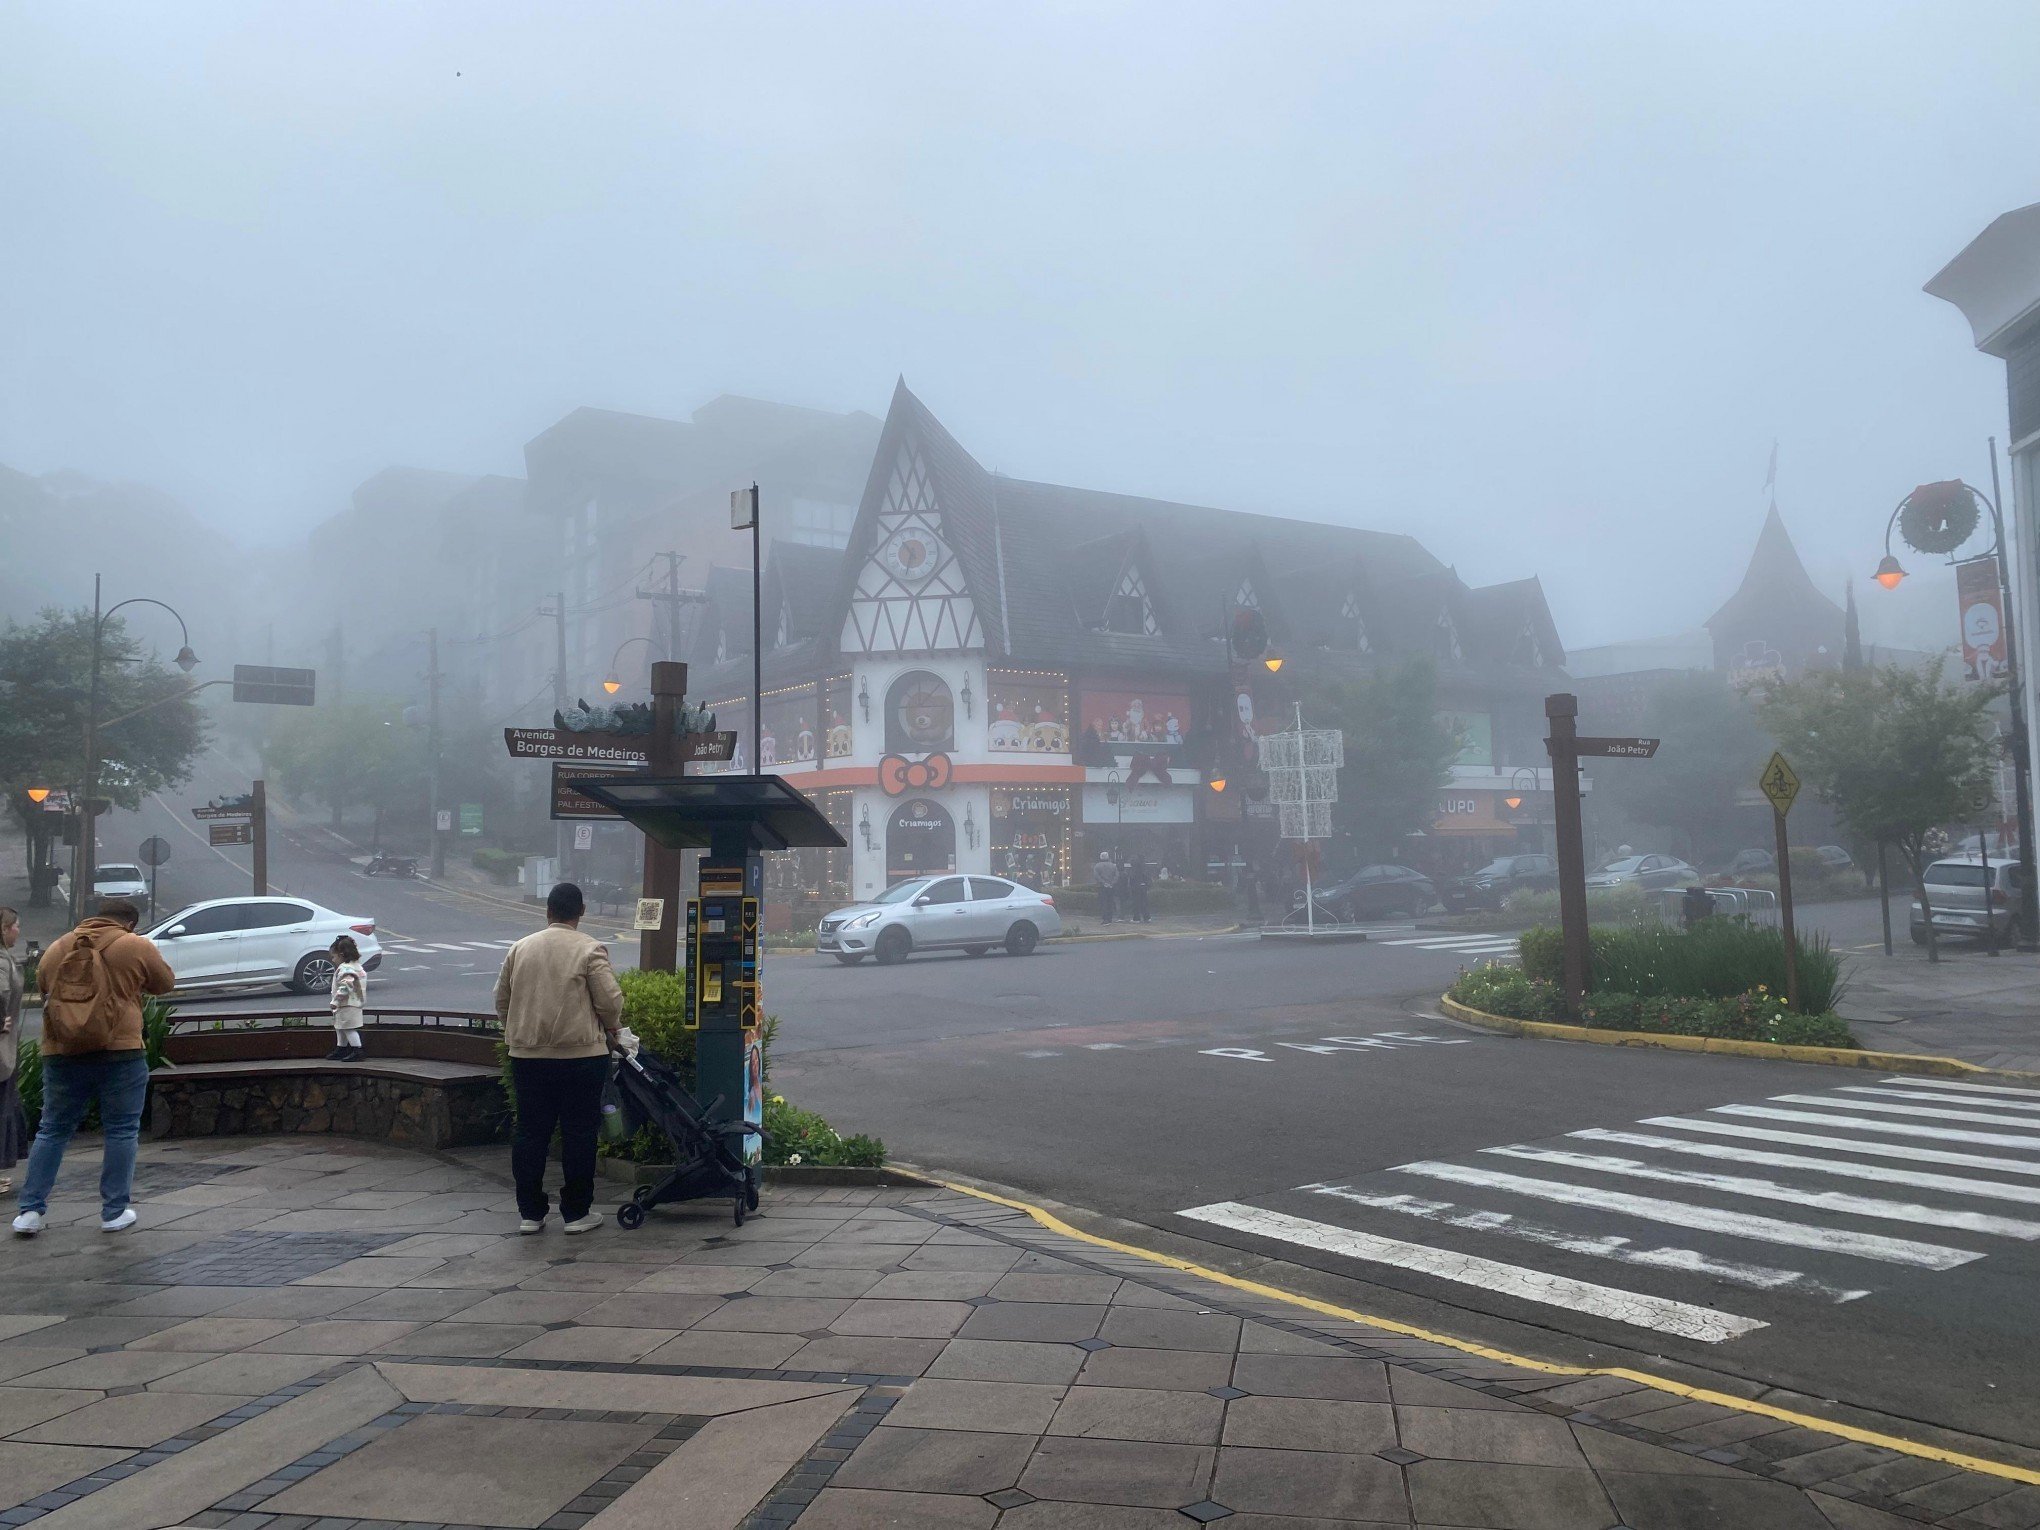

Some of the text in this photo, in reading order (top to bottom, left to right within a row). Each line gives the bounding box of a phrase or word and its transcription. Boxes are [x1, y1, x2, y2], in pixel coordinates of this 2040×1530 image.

[513, 730, 555, 740] Avenida
[717, 732, 727, 741] Rua
[1638, 738, 1651, 746] Rua
[516, 740, 646, 761] Borges de Medeiros
[693, 743, 724, 756] João Petry
[1607, 744, 1650, 756] João Petry
[557, 771, 576, 779] RUA
[1012, 796, 1071, 815] Criamigos
[1438, 799, 1475, 813] LUPO
[899, 819, 942, 830] Criamigos
[753, 865, 759, 887] P
[1197, 1031, 1473, 1062] PARE
